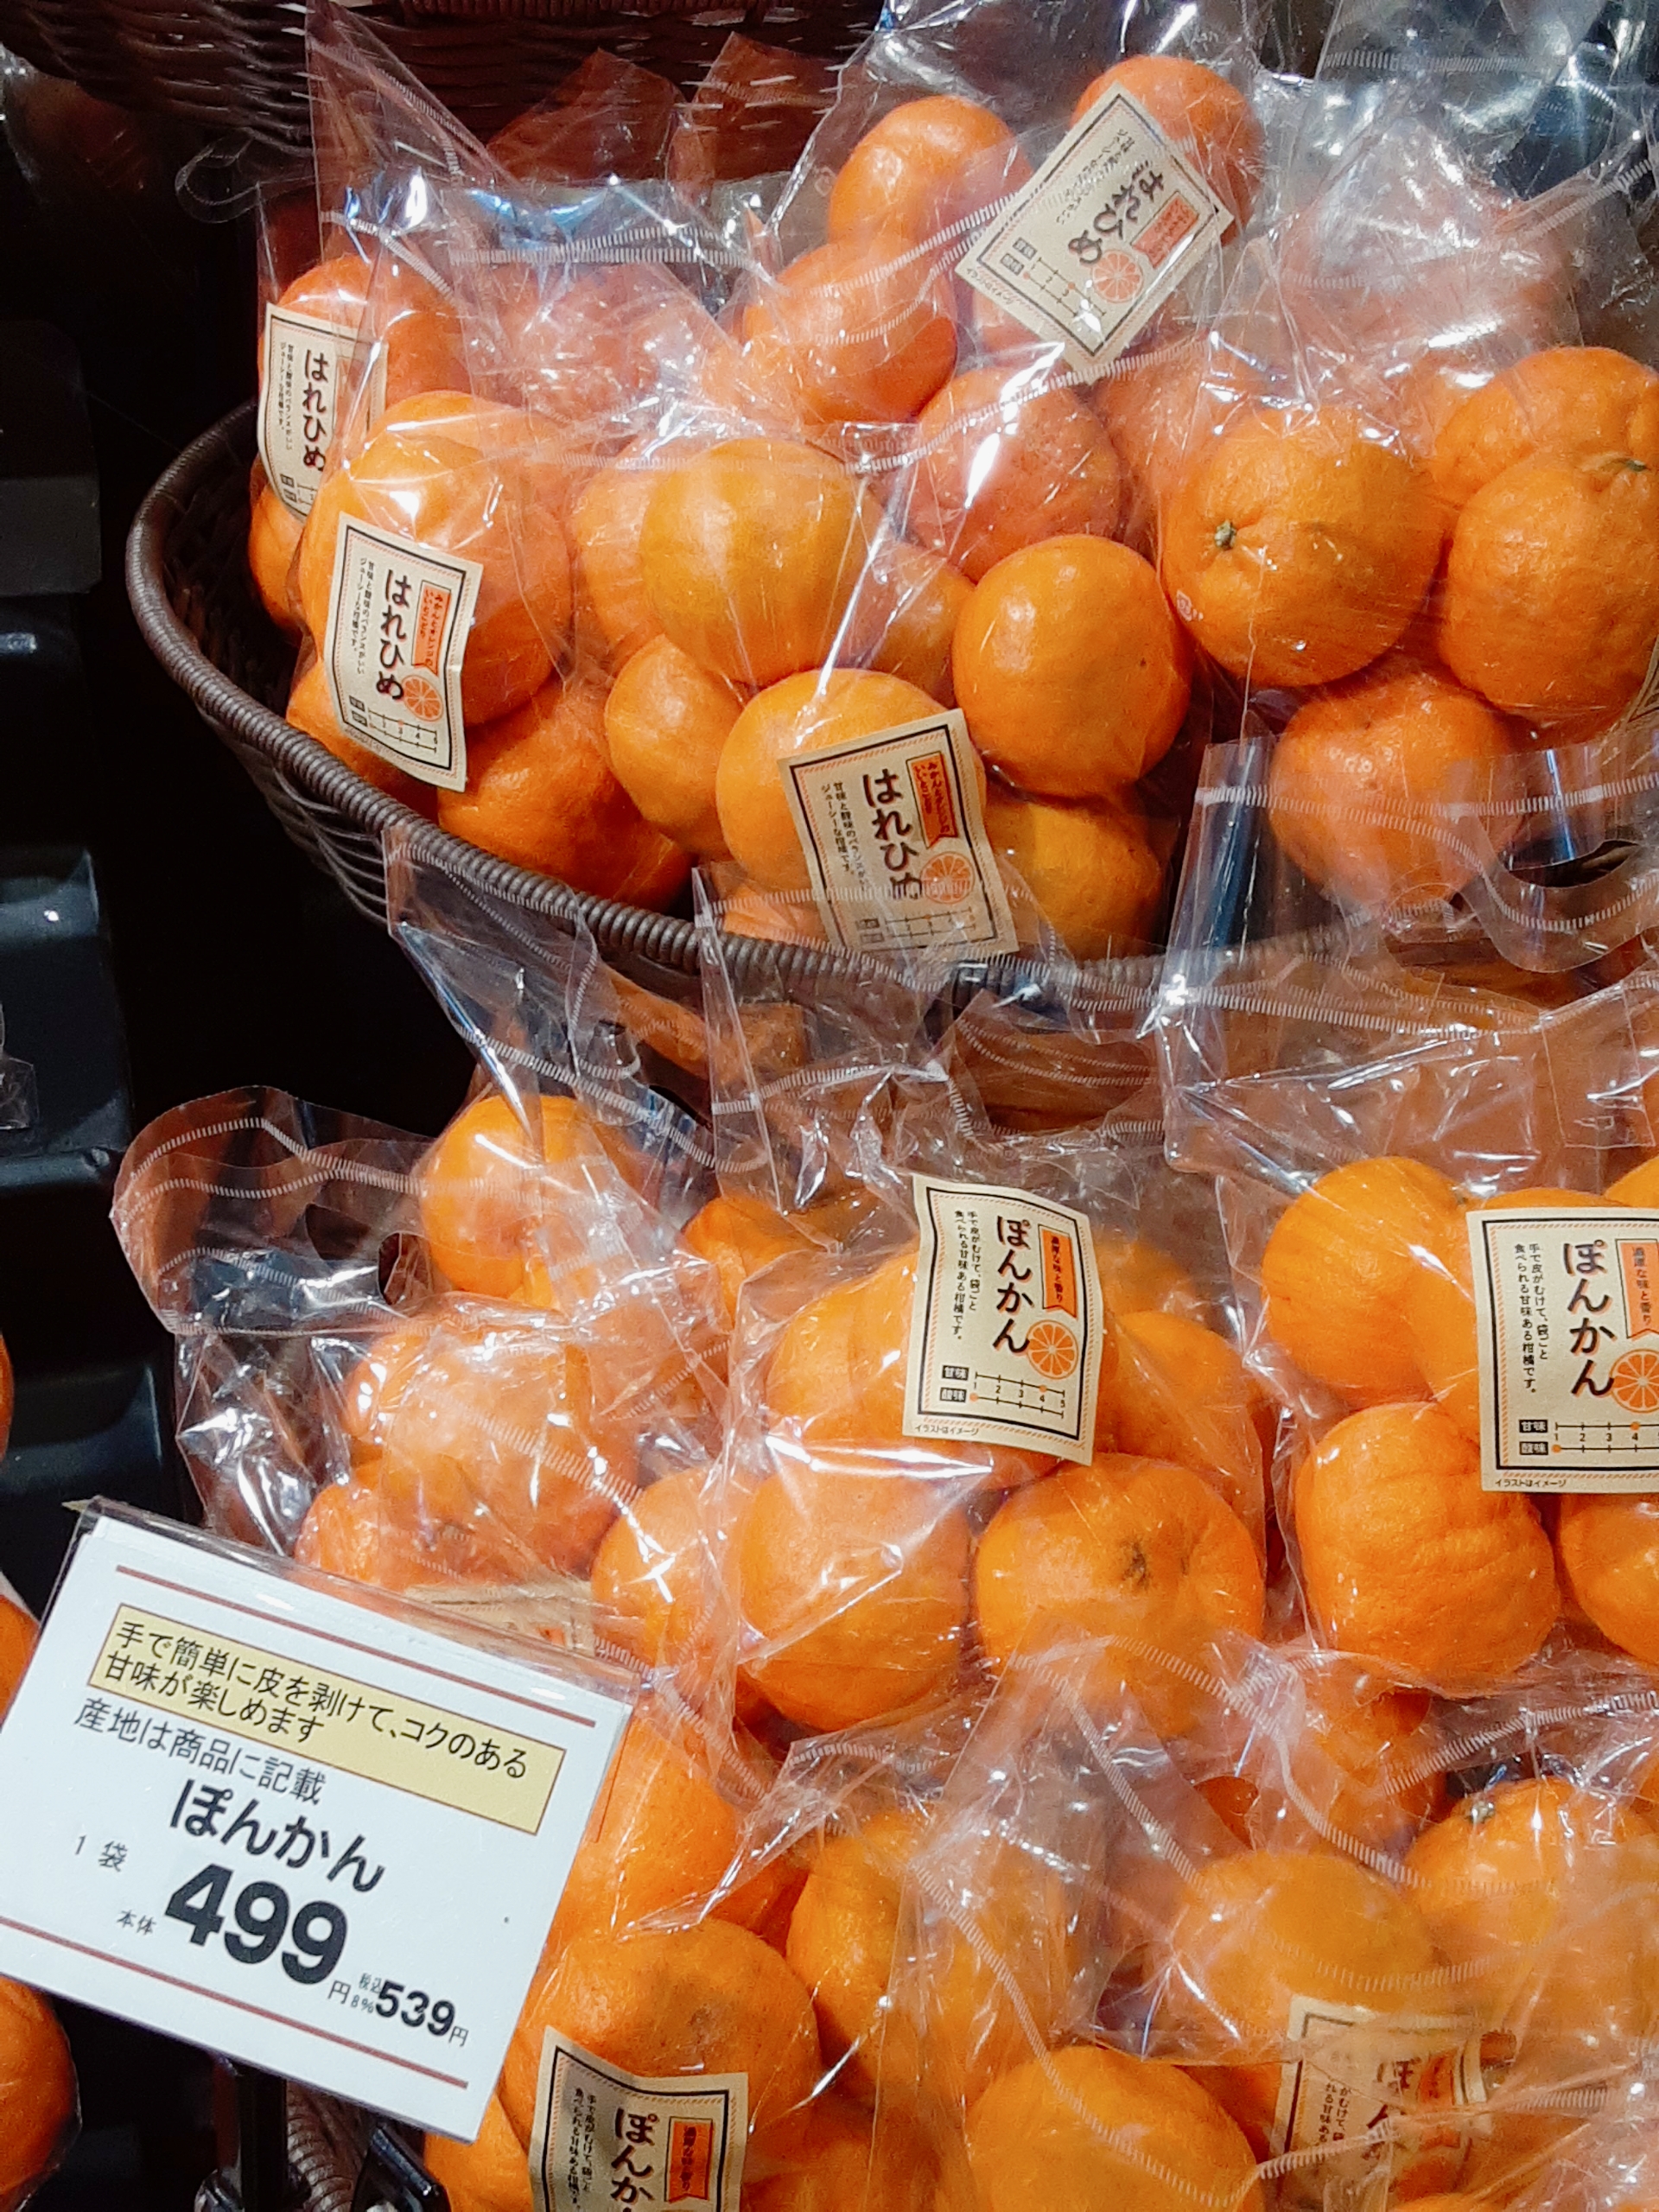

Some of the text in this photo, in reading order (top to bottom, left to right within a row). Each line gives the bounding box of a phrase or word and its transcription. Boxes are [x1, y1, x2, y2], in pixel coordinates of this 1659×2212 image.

[1068, 161, 1164, 264] はれひめ
[302, 349, 328, 472] はれひめ
[376, 569, 411, 702] はれひめ
[863, 768, 922, 899] はれひめ
[993, 1216, 1033, 1354] ぽんかん
[1515, 1243, 1537, 1394] 食べられる甘味ある柑橘です。
[1529, 1243, 1548, 1360] 手で皮がむけて、袋ごと
[1563, 1239, 1615, 1397] ぽんかん
[1521, 1421, 1546, 1432] 甘味
[74, 1698, 327, 1805] 産地は商品に記載
[105, 1650, 324, 1743] 甘味が楽しめます
[117, 1621, 526, 1778] 手で簡単に皮を剥けて、コクのある
[99, 1840, 129, 1872] 袋
[170, 1778, 385, 1892] ぽんかん
[117, 1910, 157, 1936] 本体
[611, 2107, 659, 2212] ぽんか
